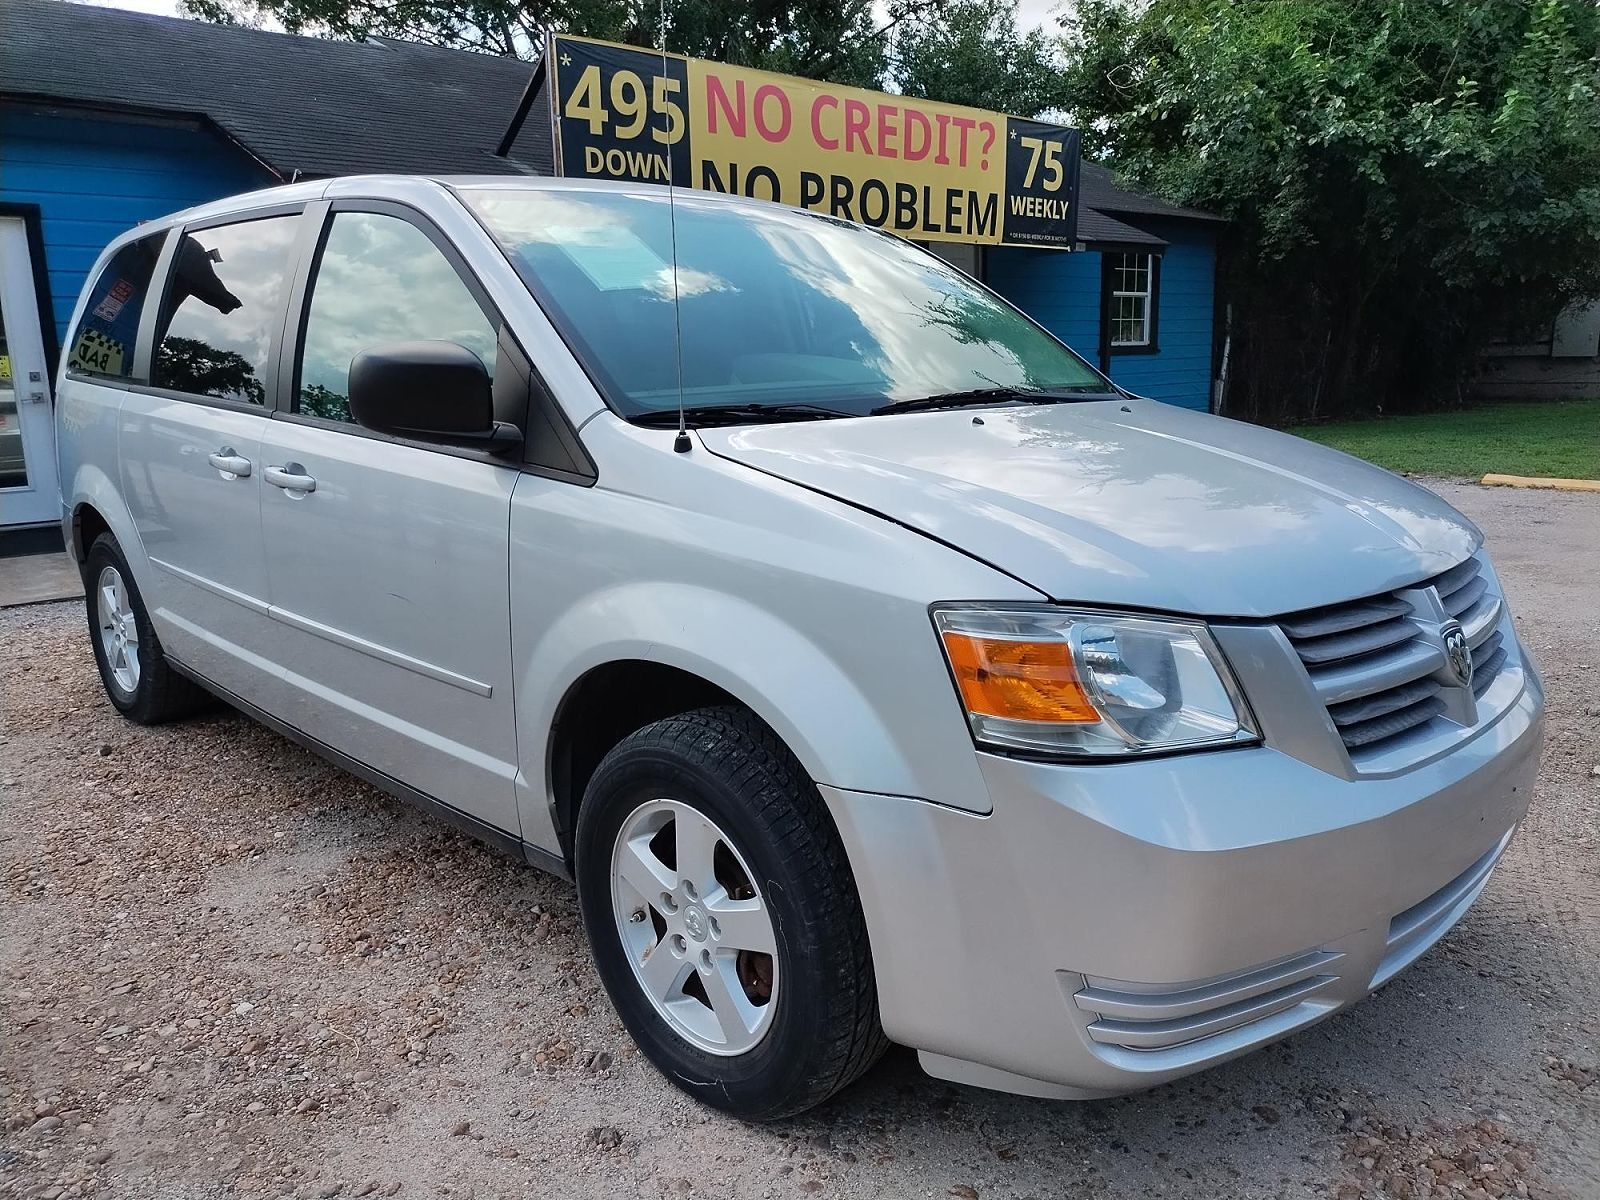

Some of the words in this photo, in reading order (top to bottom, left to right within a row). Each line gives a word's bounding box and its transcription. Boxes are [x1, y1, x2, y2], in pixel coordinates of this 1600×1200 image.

[706, 75, 792, 143] NO
[811, 95, 996, 171] CREDIT?
[585, 146, 671, 180] DOWN
[702, 160, 781, 203] NO
[801, 171, 998, 237] PROBLEM
[1011, 195, 1069, 220] WEEKLY
